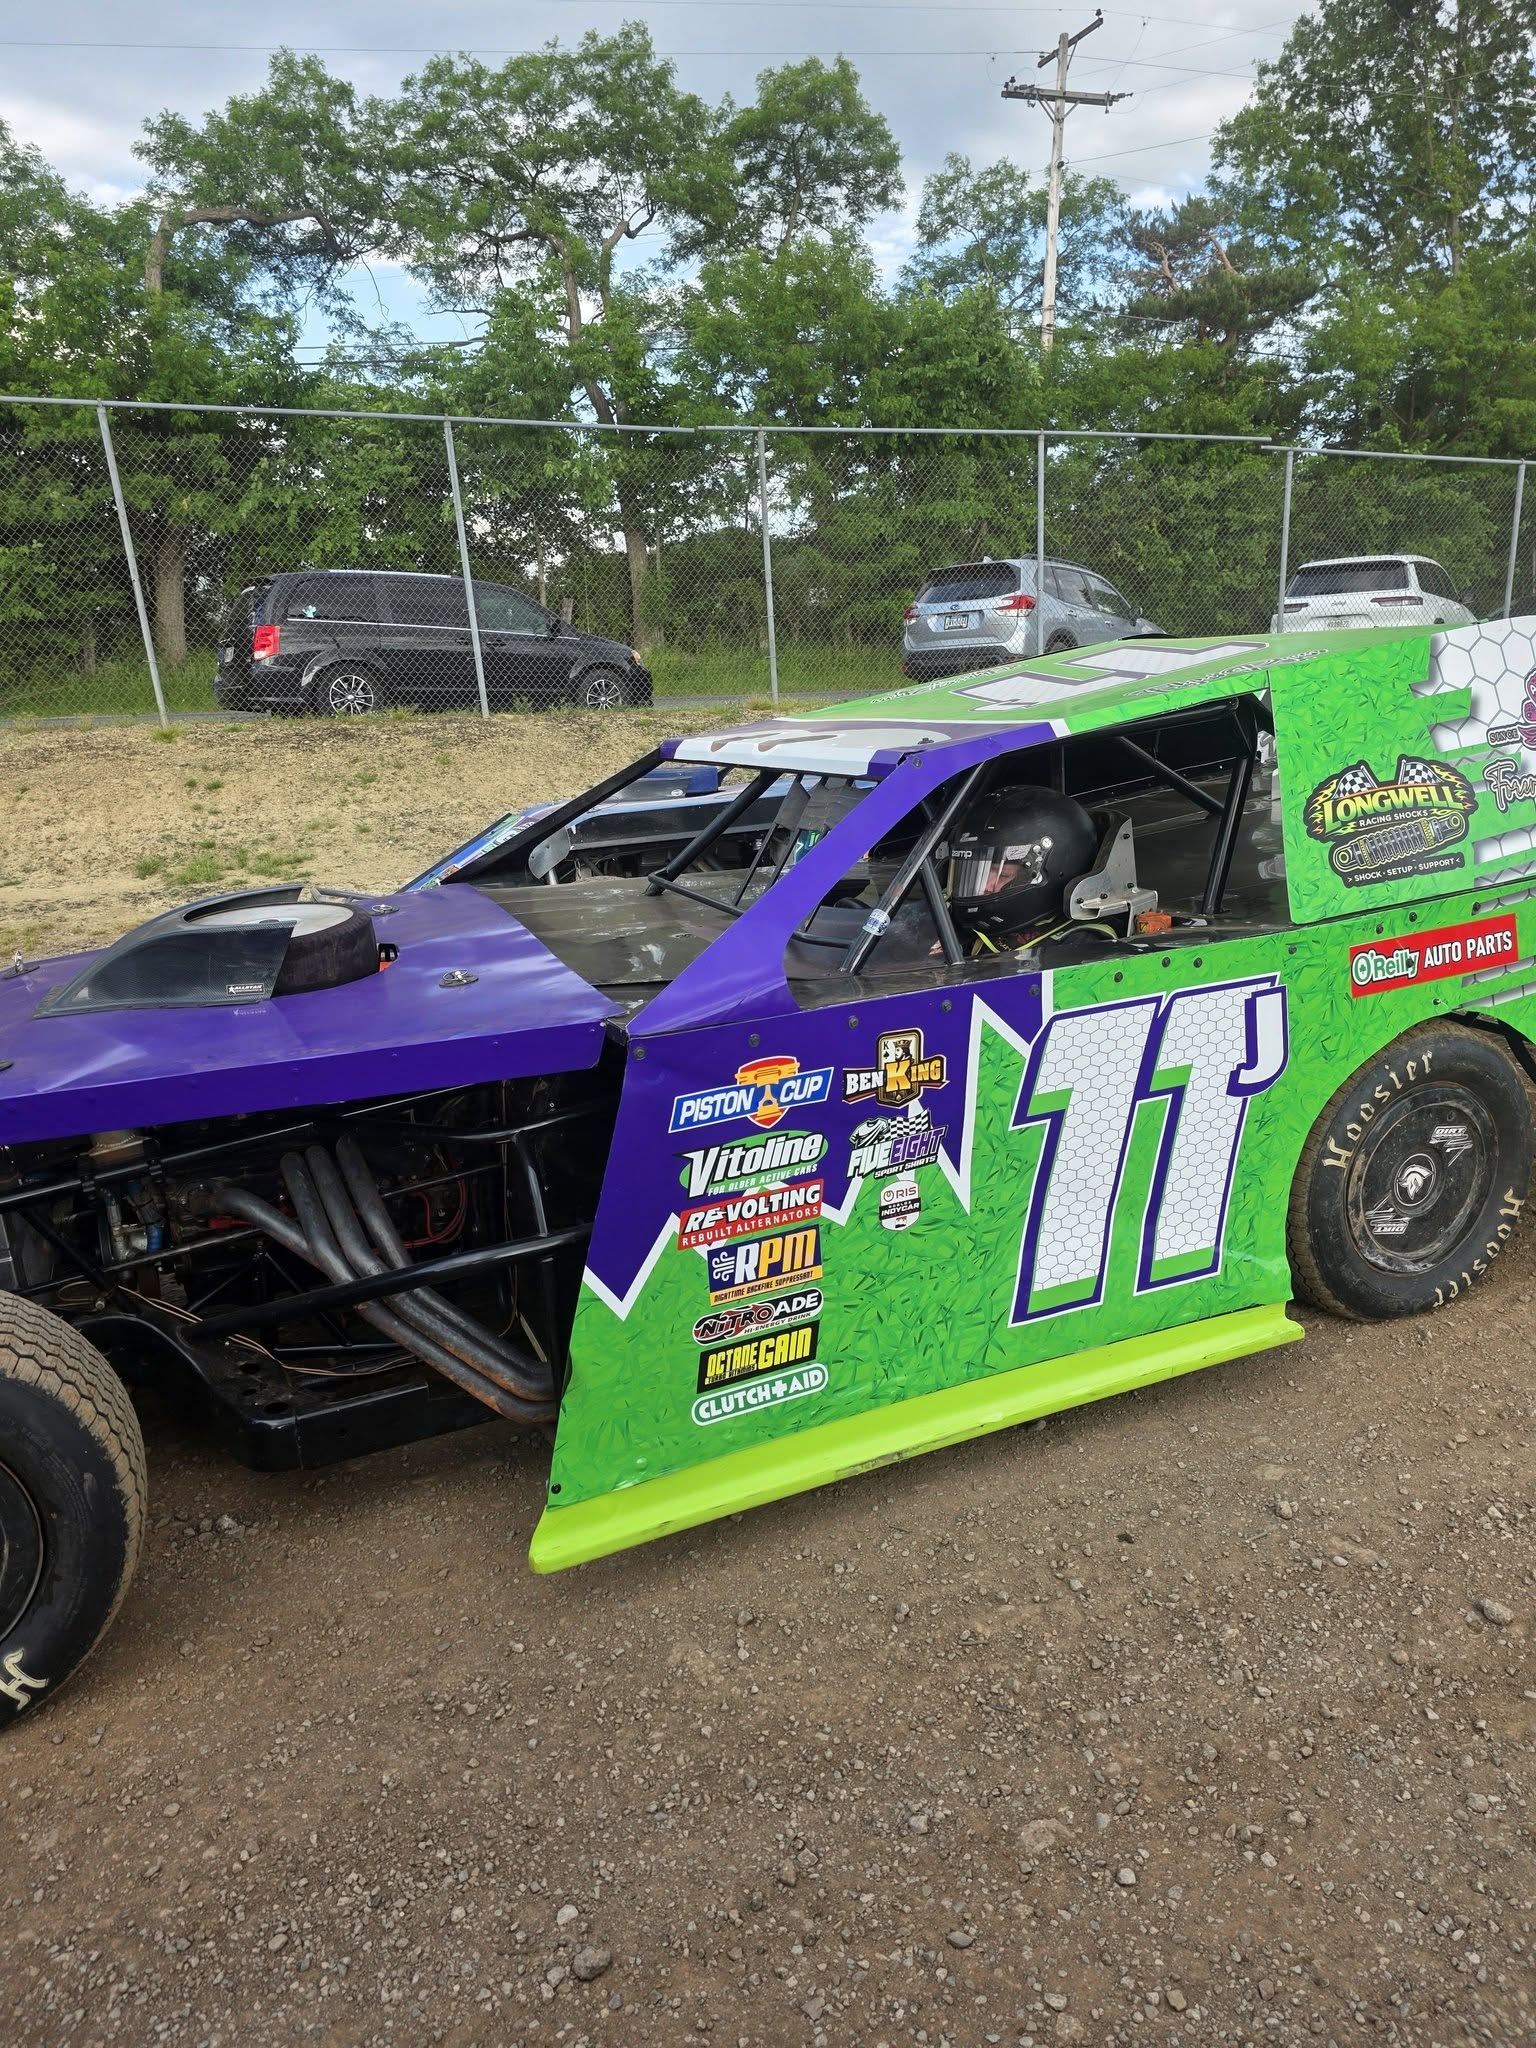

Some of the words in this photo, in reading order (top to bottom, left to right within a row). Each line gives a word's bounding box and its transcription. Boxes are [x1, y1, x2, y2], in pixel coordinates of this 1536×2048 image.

[1489, 729, 1519, 743] SINCE
[1323, 786, 1464, 833] LONGWELL
[1359, 815, 1392, 827] RACING
[1394, 810, 1428, 820] SHOCKS
[1354, 871, 1382, 882] SHOCK
[1387, 865, 1413, 876] SETUP
[1418, 858, 1454, 870] SUPPORT
[1353, 949, 1419, 985] O'Reilly
[1424, 942, 1462, 969] AUTO
[1466, 930, 1513, 959] PARTS
[846, 1071, 884, 1095] BEN
[679, 1086, 755, 1125] PISTON
[779, 1074, 824, 1102] CUP
[682, 1133, 824, 1198] Vitoline
[874, 1164, 904, 1178] SPORT
[905, 1156, 936, 1169] SHIRTS
[708, 1185, 725, 1196] FOR
[728, 1178, 756, 1191] OLDER
[759, 1170, 791, 1184] ACTIVE
[794, 1164, 818, 1176] CARS
[881, 1202, 919, 1216] INDYCAR
[682, 1225, 732, 1246] REBUILT
[736, 1206, 819, 1233] ALTERNATORS
[734, 1229, 817, 1284] RPM
[747, 1282, 773, 1294] BACKFIRE
[744, 1320, 786, 1333] HI-ENERGY
[788, 1312, 811, 1322] DRINK
